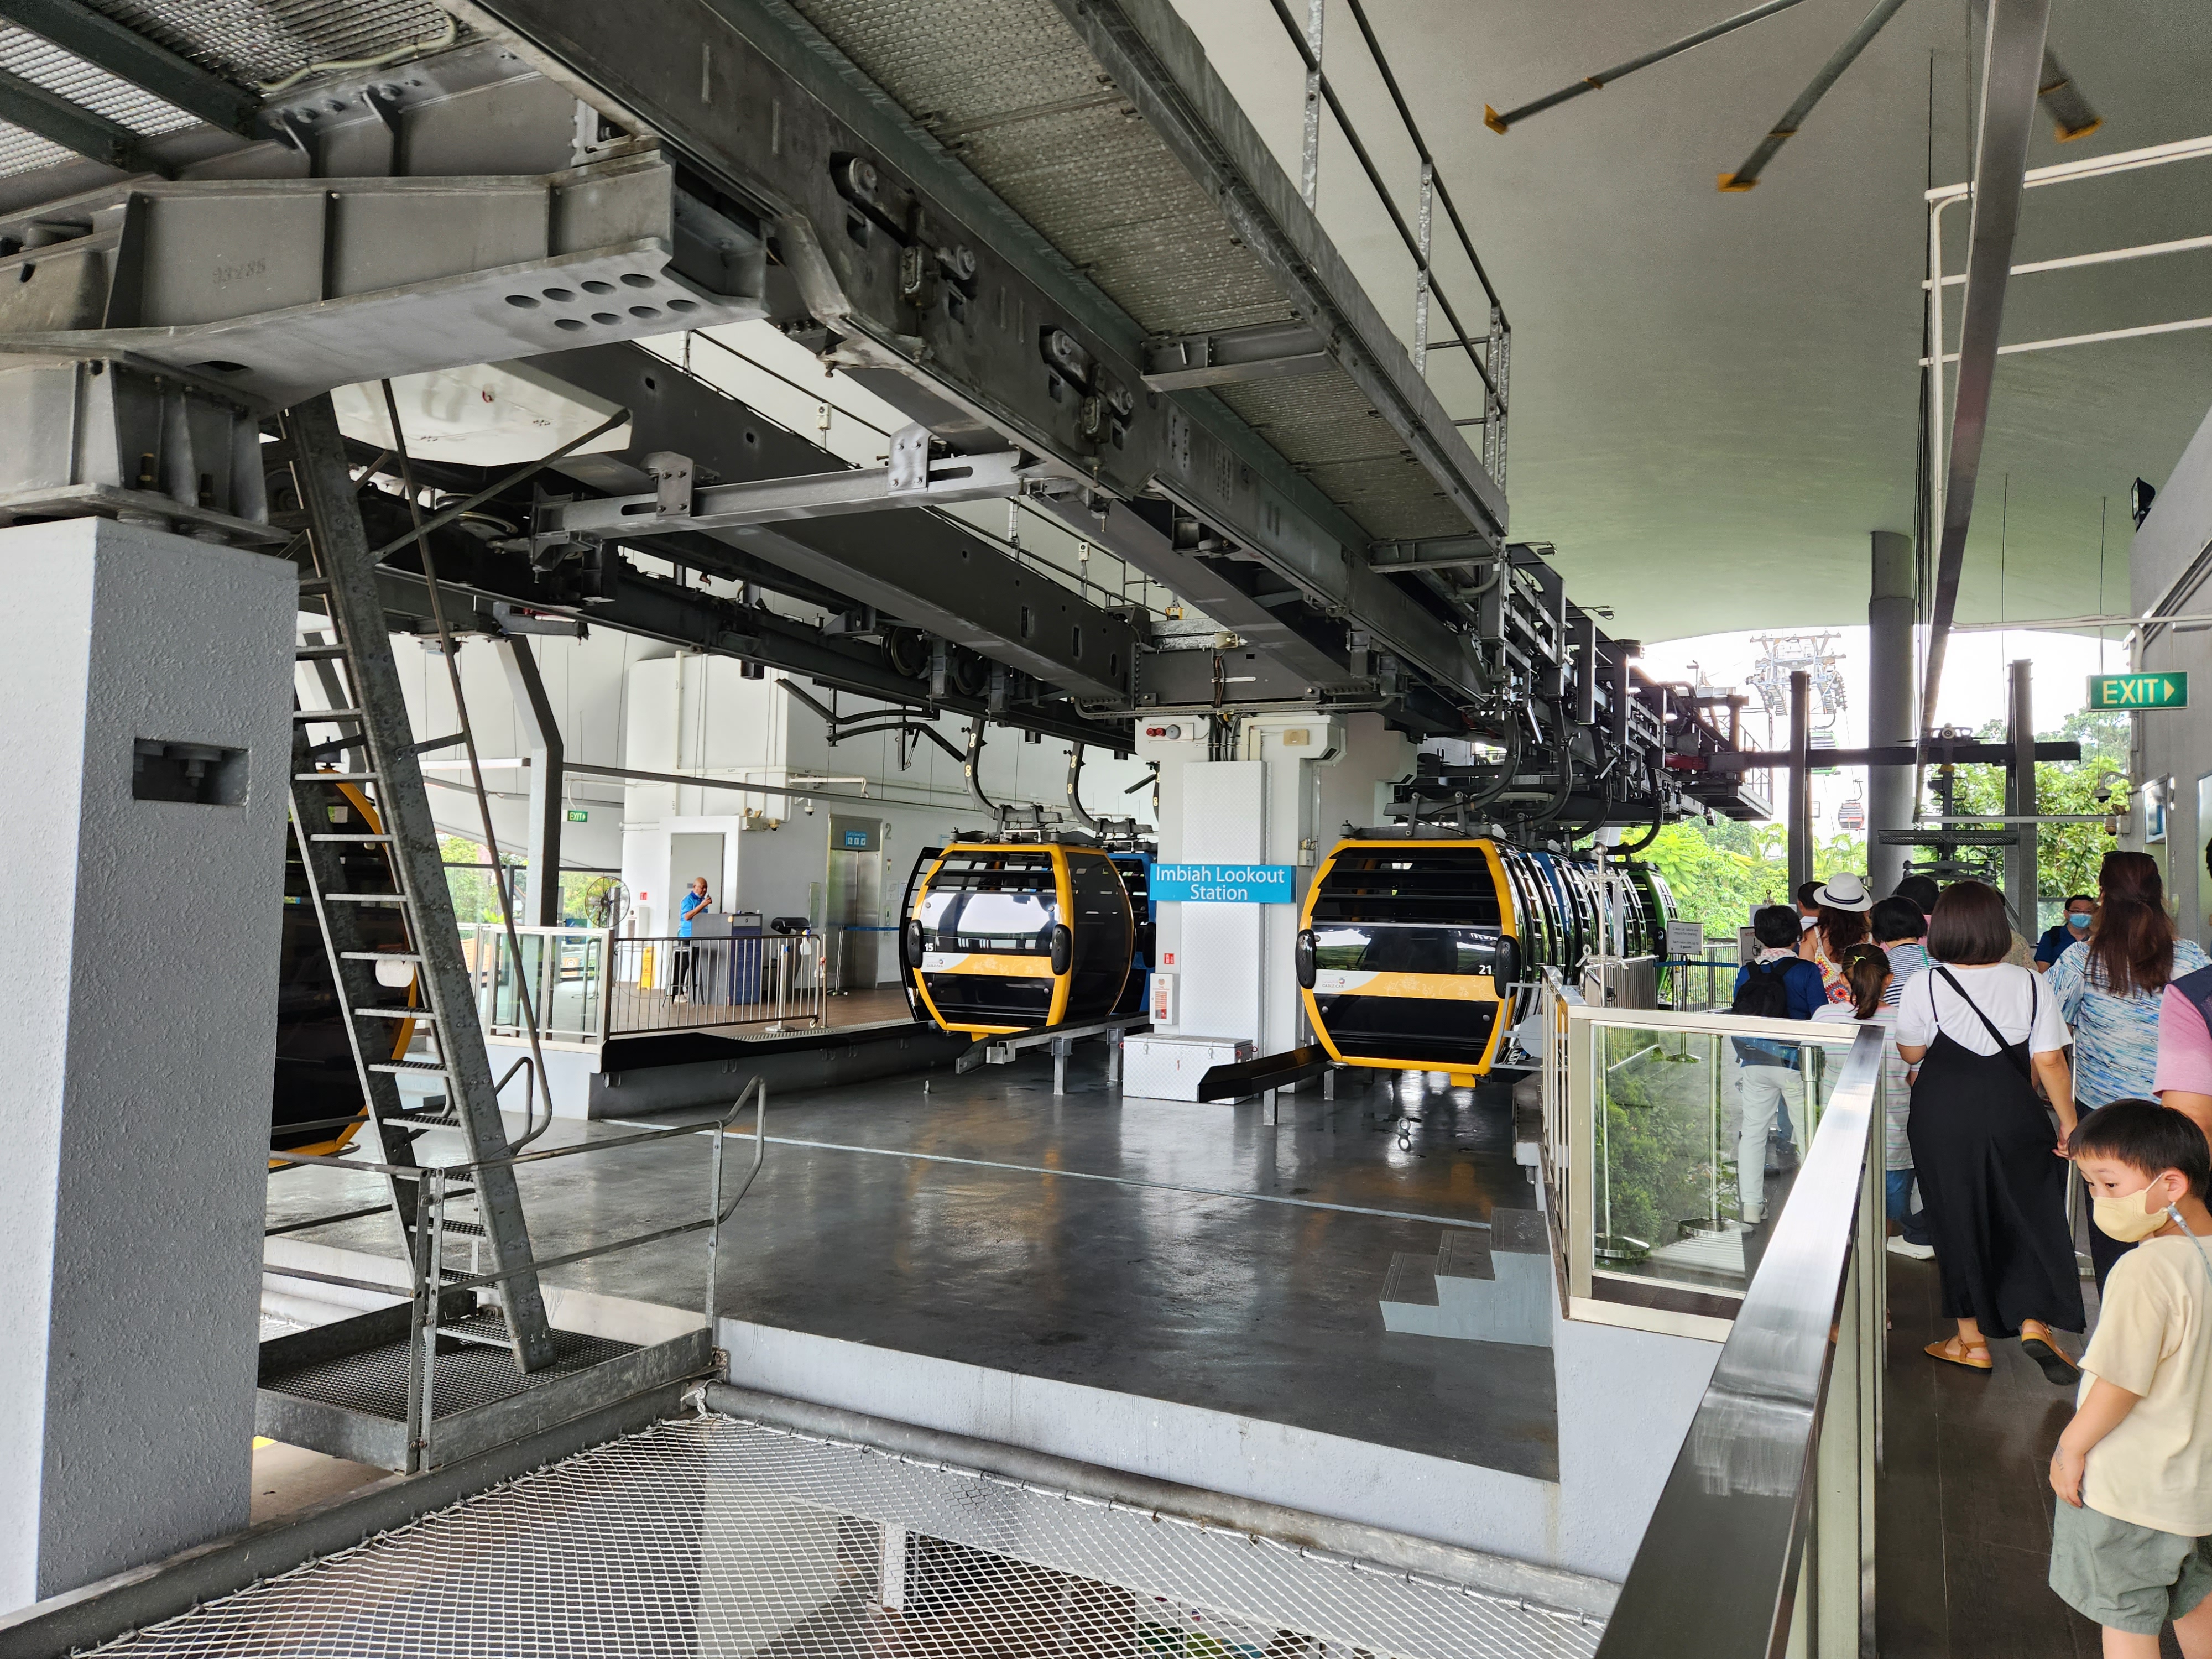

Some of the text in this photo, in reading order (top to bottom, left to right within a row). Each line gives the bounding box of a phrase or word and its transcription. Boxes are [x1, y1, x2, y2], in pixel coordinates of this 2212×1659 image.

[2103, 679, 2159, 704] EXIT
[569, 812, 583, 821] EXIT
[885, 822, 891, 840] 2
[1156, 865, 1285, 883] Imbiah Lookout
[1190, 884, 1248, 900] Station
[924, 942, 934, 952] 15
[1479, 964, 1492, 975] 21
